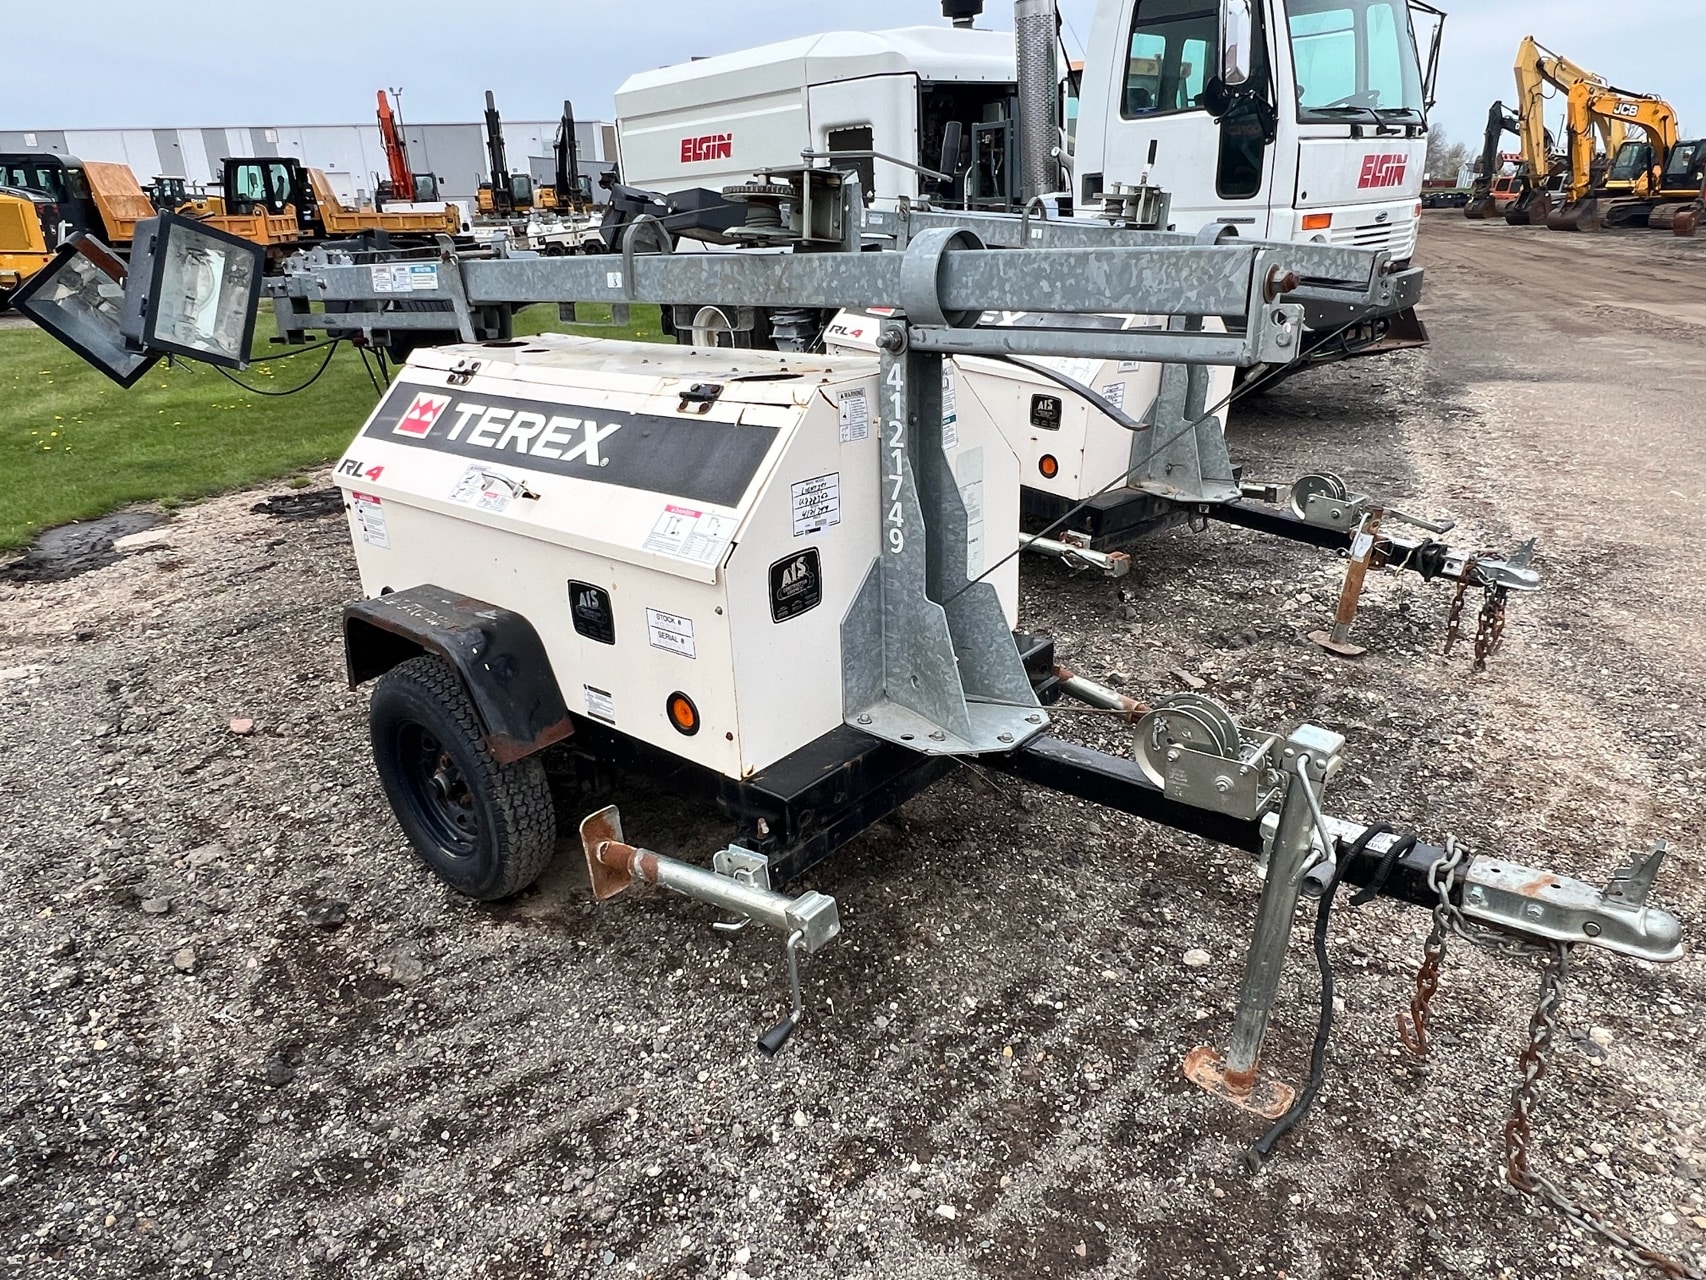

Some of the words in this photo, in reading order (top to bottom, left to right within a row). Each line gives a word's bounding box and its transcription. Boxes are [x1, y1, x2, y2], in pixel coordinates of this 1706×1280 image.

[1613, 102, 1639, 117] JCB
[681, 133, 732, 163] ELGIN
[1357, 153, 1409, 189] ELGIN
[828, 325, 864, 338] RL4
[1037, 400, 1054, 411] AIS
[446, 401, 623, 467] TEREX
[886, 363, 905, 554] 4121749
[337, 458, 386, 482] RL4
[781, 556, 807, 588] AIS
[579, 589, 599, 608] AIS
[656, 612, 676, 625] STOCK
[657, 630, 679, 643] SERIAL
